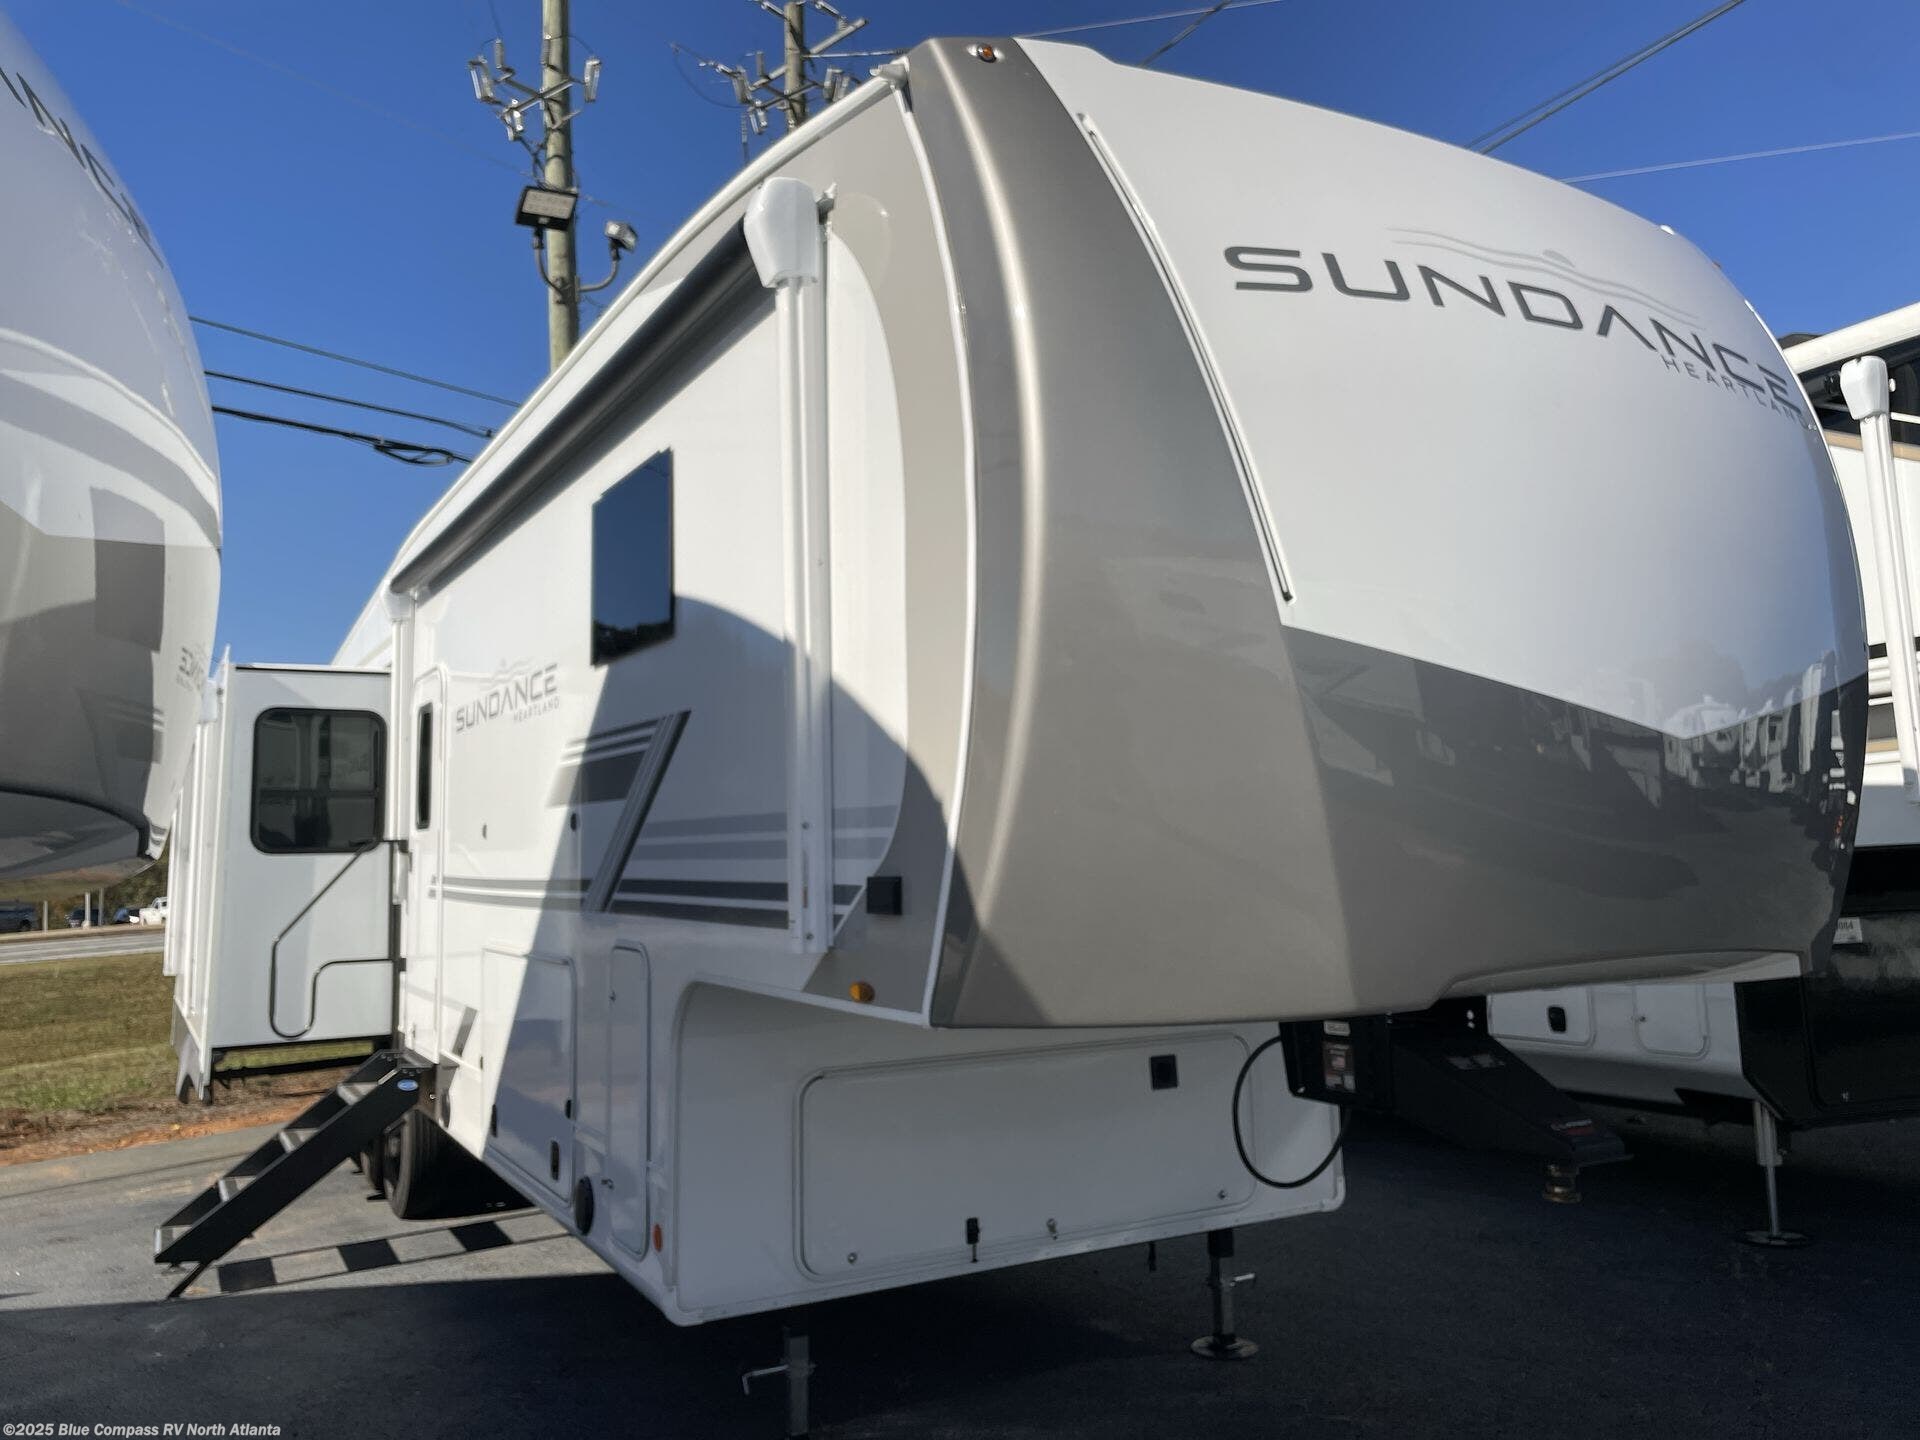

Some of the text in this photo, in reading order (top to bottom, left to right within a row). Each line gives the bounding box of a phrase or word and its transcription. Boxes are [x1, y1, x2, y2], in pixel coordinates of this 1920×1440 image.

[1224, 246, 1801, 414] SUNDANCE
[1660, 353, 1811, 430] HEARTLAND
[456, 663, 558, 733] SUNDANCE
[513, 696, 560, 722] HEARTLAND
